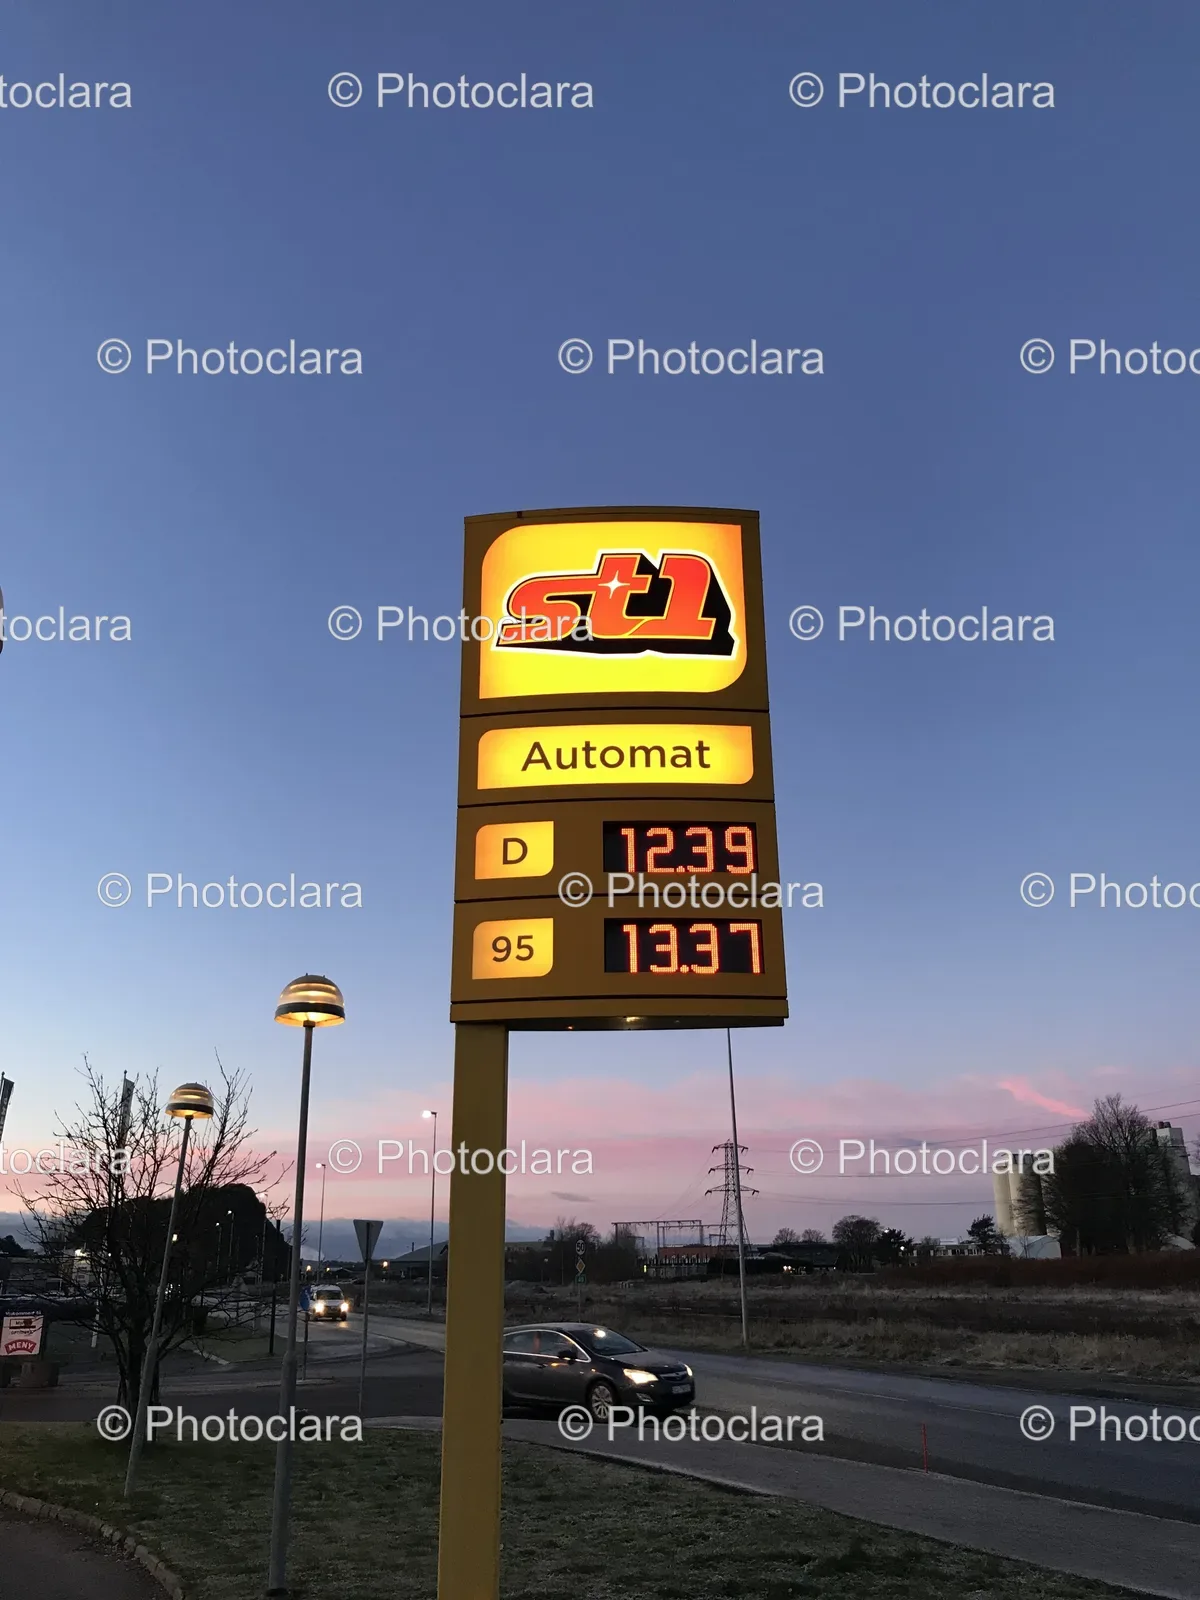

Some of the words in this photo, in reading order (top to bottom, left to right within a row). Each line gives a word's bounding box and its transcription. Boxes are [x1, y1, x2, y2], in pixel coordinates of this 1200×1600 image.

[521, 740, 711, 771] Automat
[502, 838, 528, 865] D
[621, 826, 754, 874] 12.39
[491, 934, 534, 963] 95
[623, 923, 760, 974] 13.37
[576, 1242, 584, 1252] 50
[8, 1341, 34, 1351] MENY
